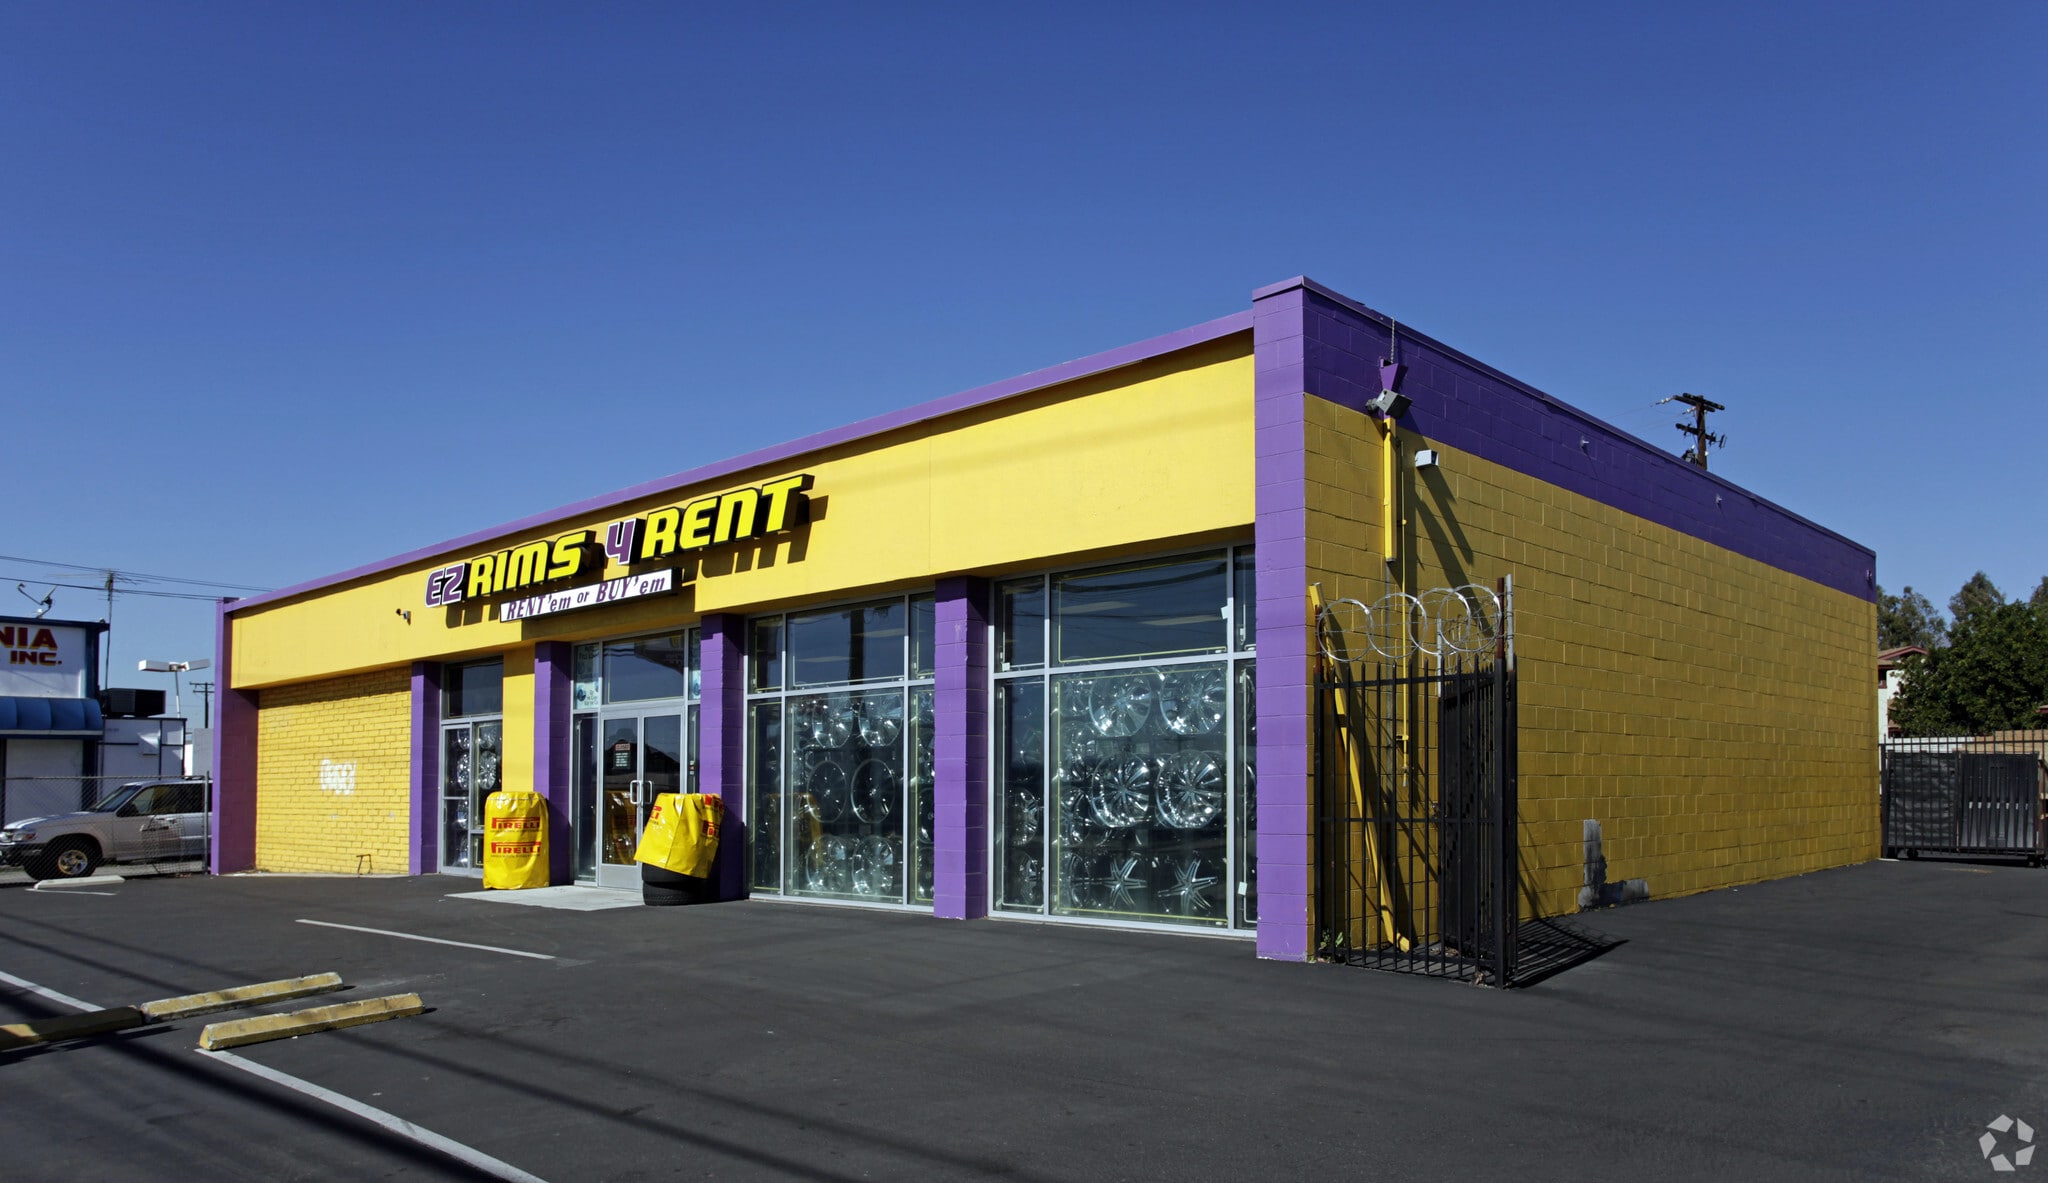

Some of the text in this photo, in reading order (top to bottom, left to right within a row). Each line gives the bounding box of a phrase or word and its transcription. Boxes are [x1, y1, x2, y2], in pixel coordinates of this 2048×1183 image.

[425, 475, 804, 608] EZ RIMS 4 RENT
[577, 590, 590, 604] or
[10, 650, 62, 666] INC.
[491, 816, 540, 829] PIRELLI
[491, 841, 541, 854] PIRELLI
